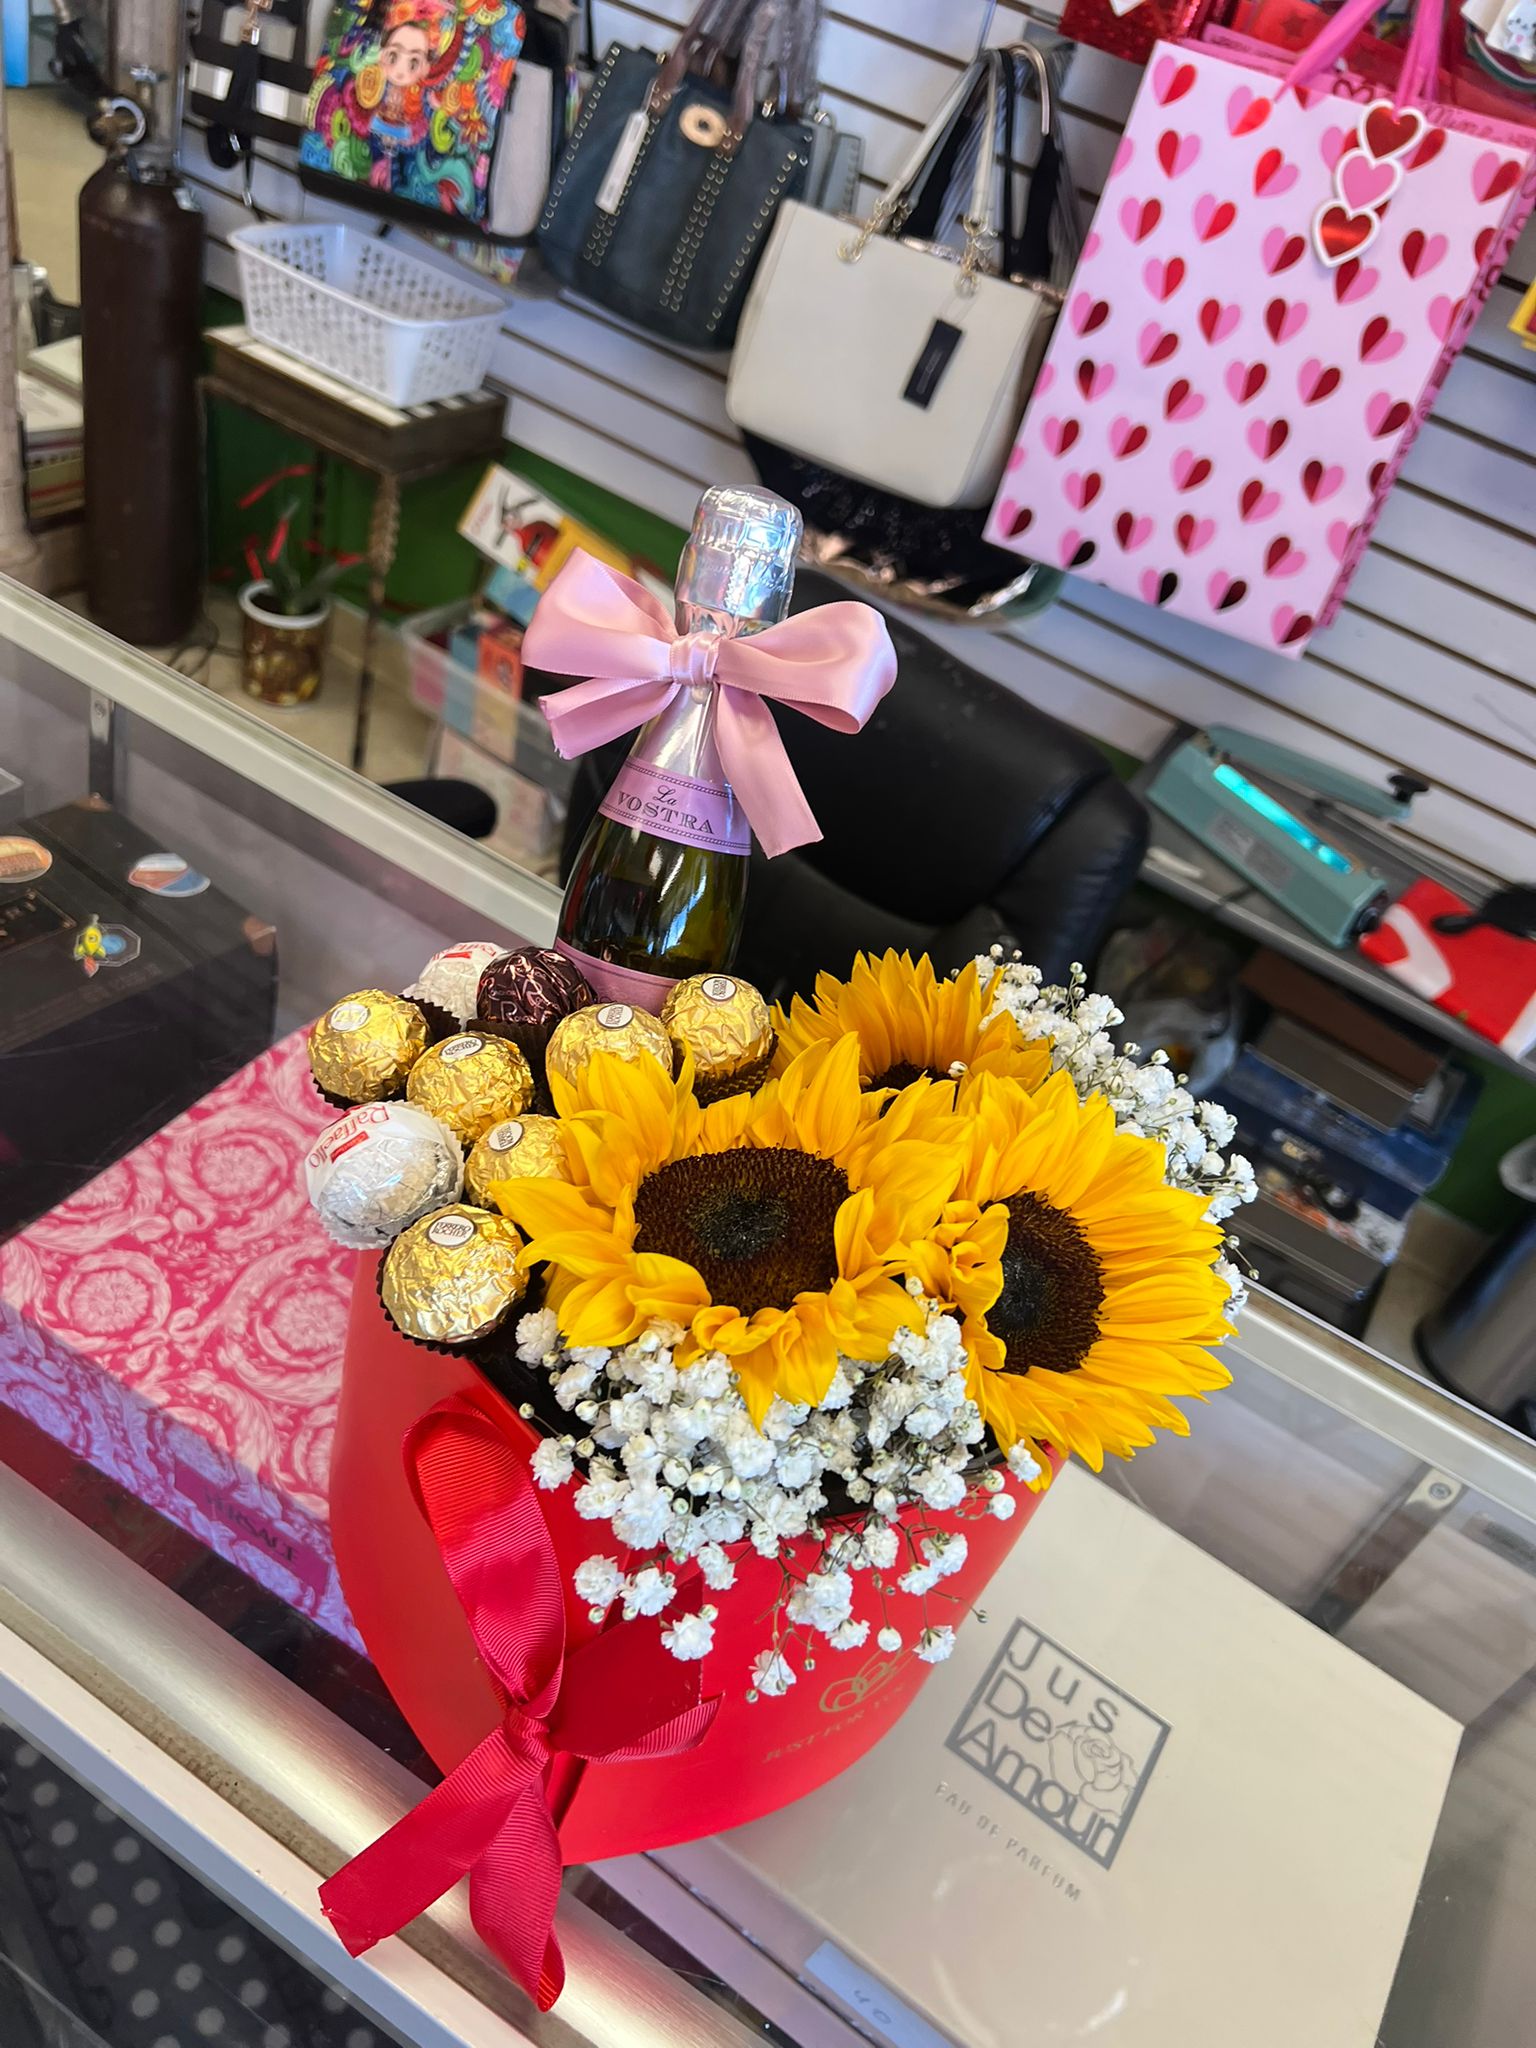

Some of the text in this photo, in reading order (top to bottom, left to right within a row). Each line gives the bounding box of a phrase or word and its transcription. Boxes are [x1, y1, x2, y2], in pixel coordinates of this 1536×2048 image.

[617, 790, 715, 835] VOSTRA
[652, 784, 677, 806] La
[308, 1105, 390, 1168] Raffaello
[983, 1669, 1052, 1743] De
[1007, 1635, 1119, 1734] Jus
[956, 1718, 1119, 1859] Amour
